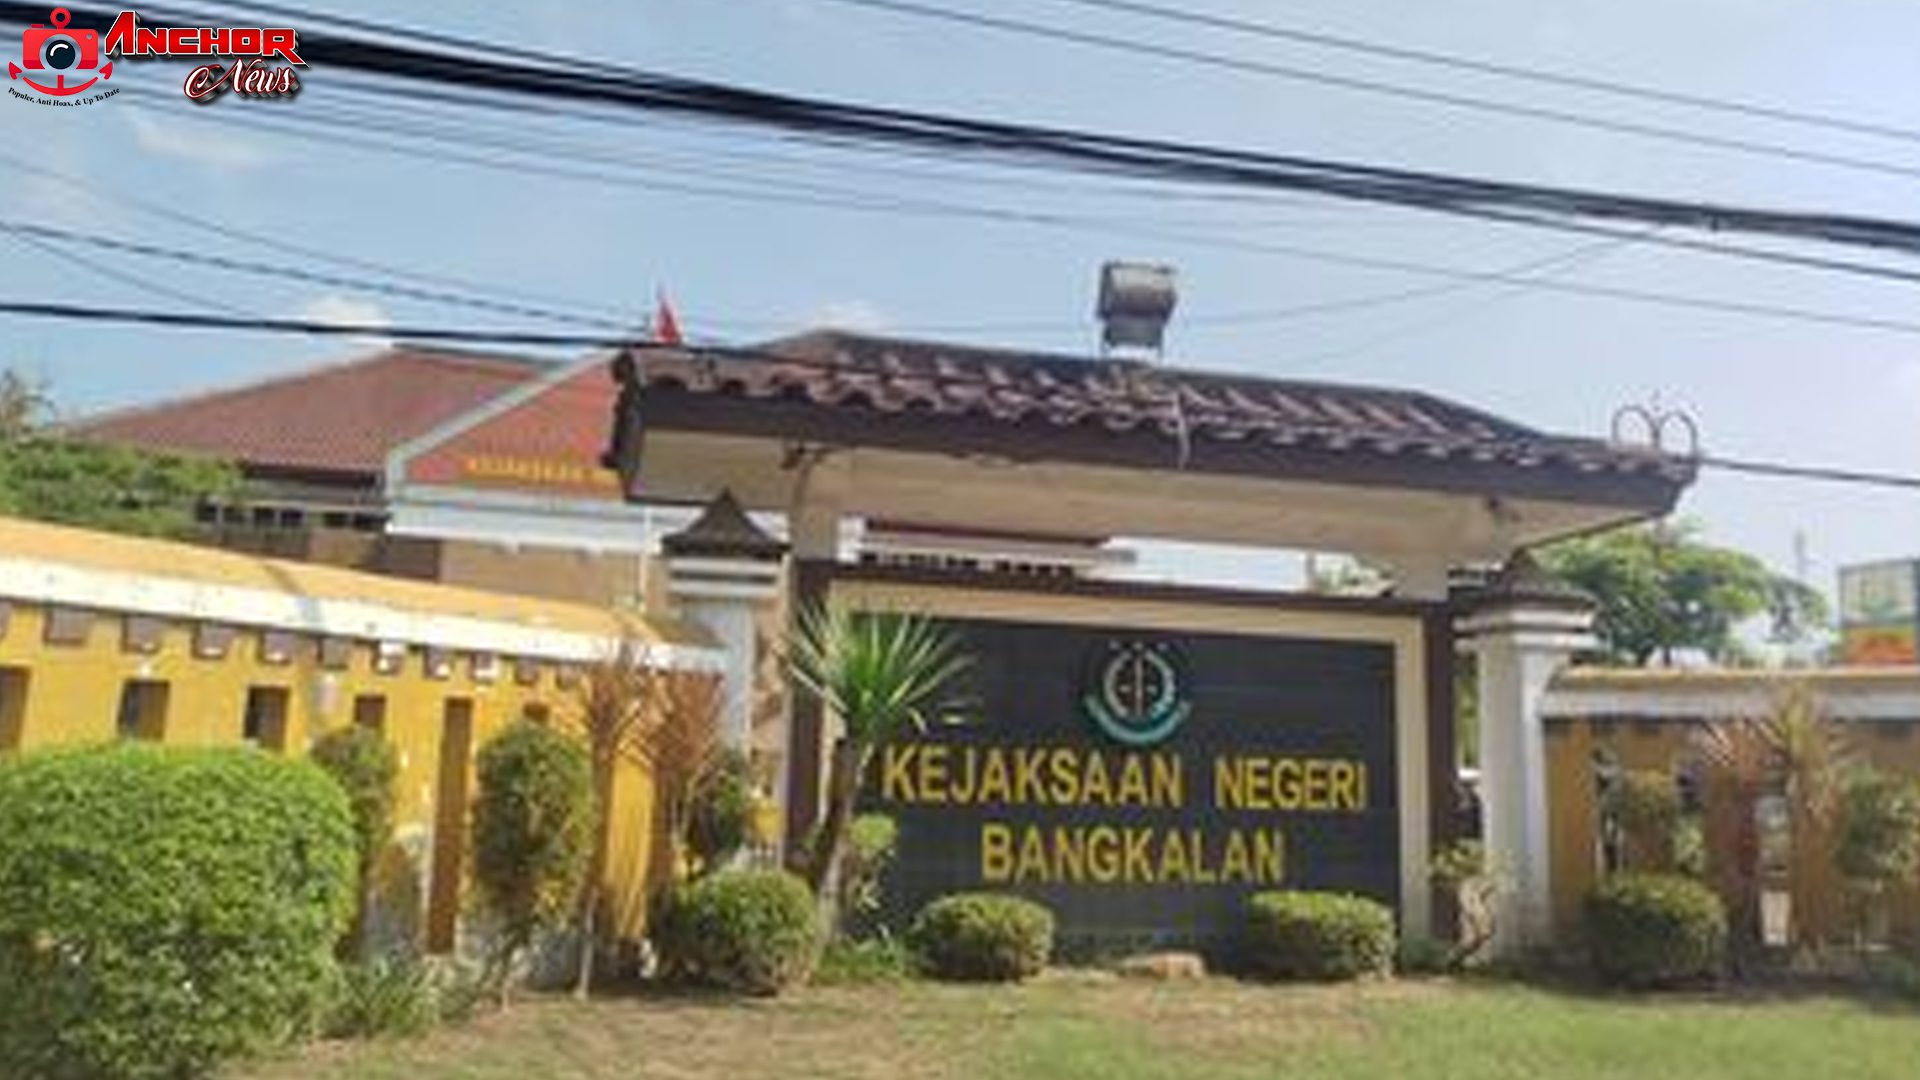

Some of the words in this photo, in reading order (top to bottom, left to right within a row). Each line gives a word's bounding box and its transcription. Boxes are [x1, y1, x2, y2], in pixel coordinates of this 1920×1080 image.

[882, 746, 1182, 807] KEJAKSAAN
[1215, 758, 1366, 812] NEGERI
[981, 823, 1283, 884] BANGKALAN
